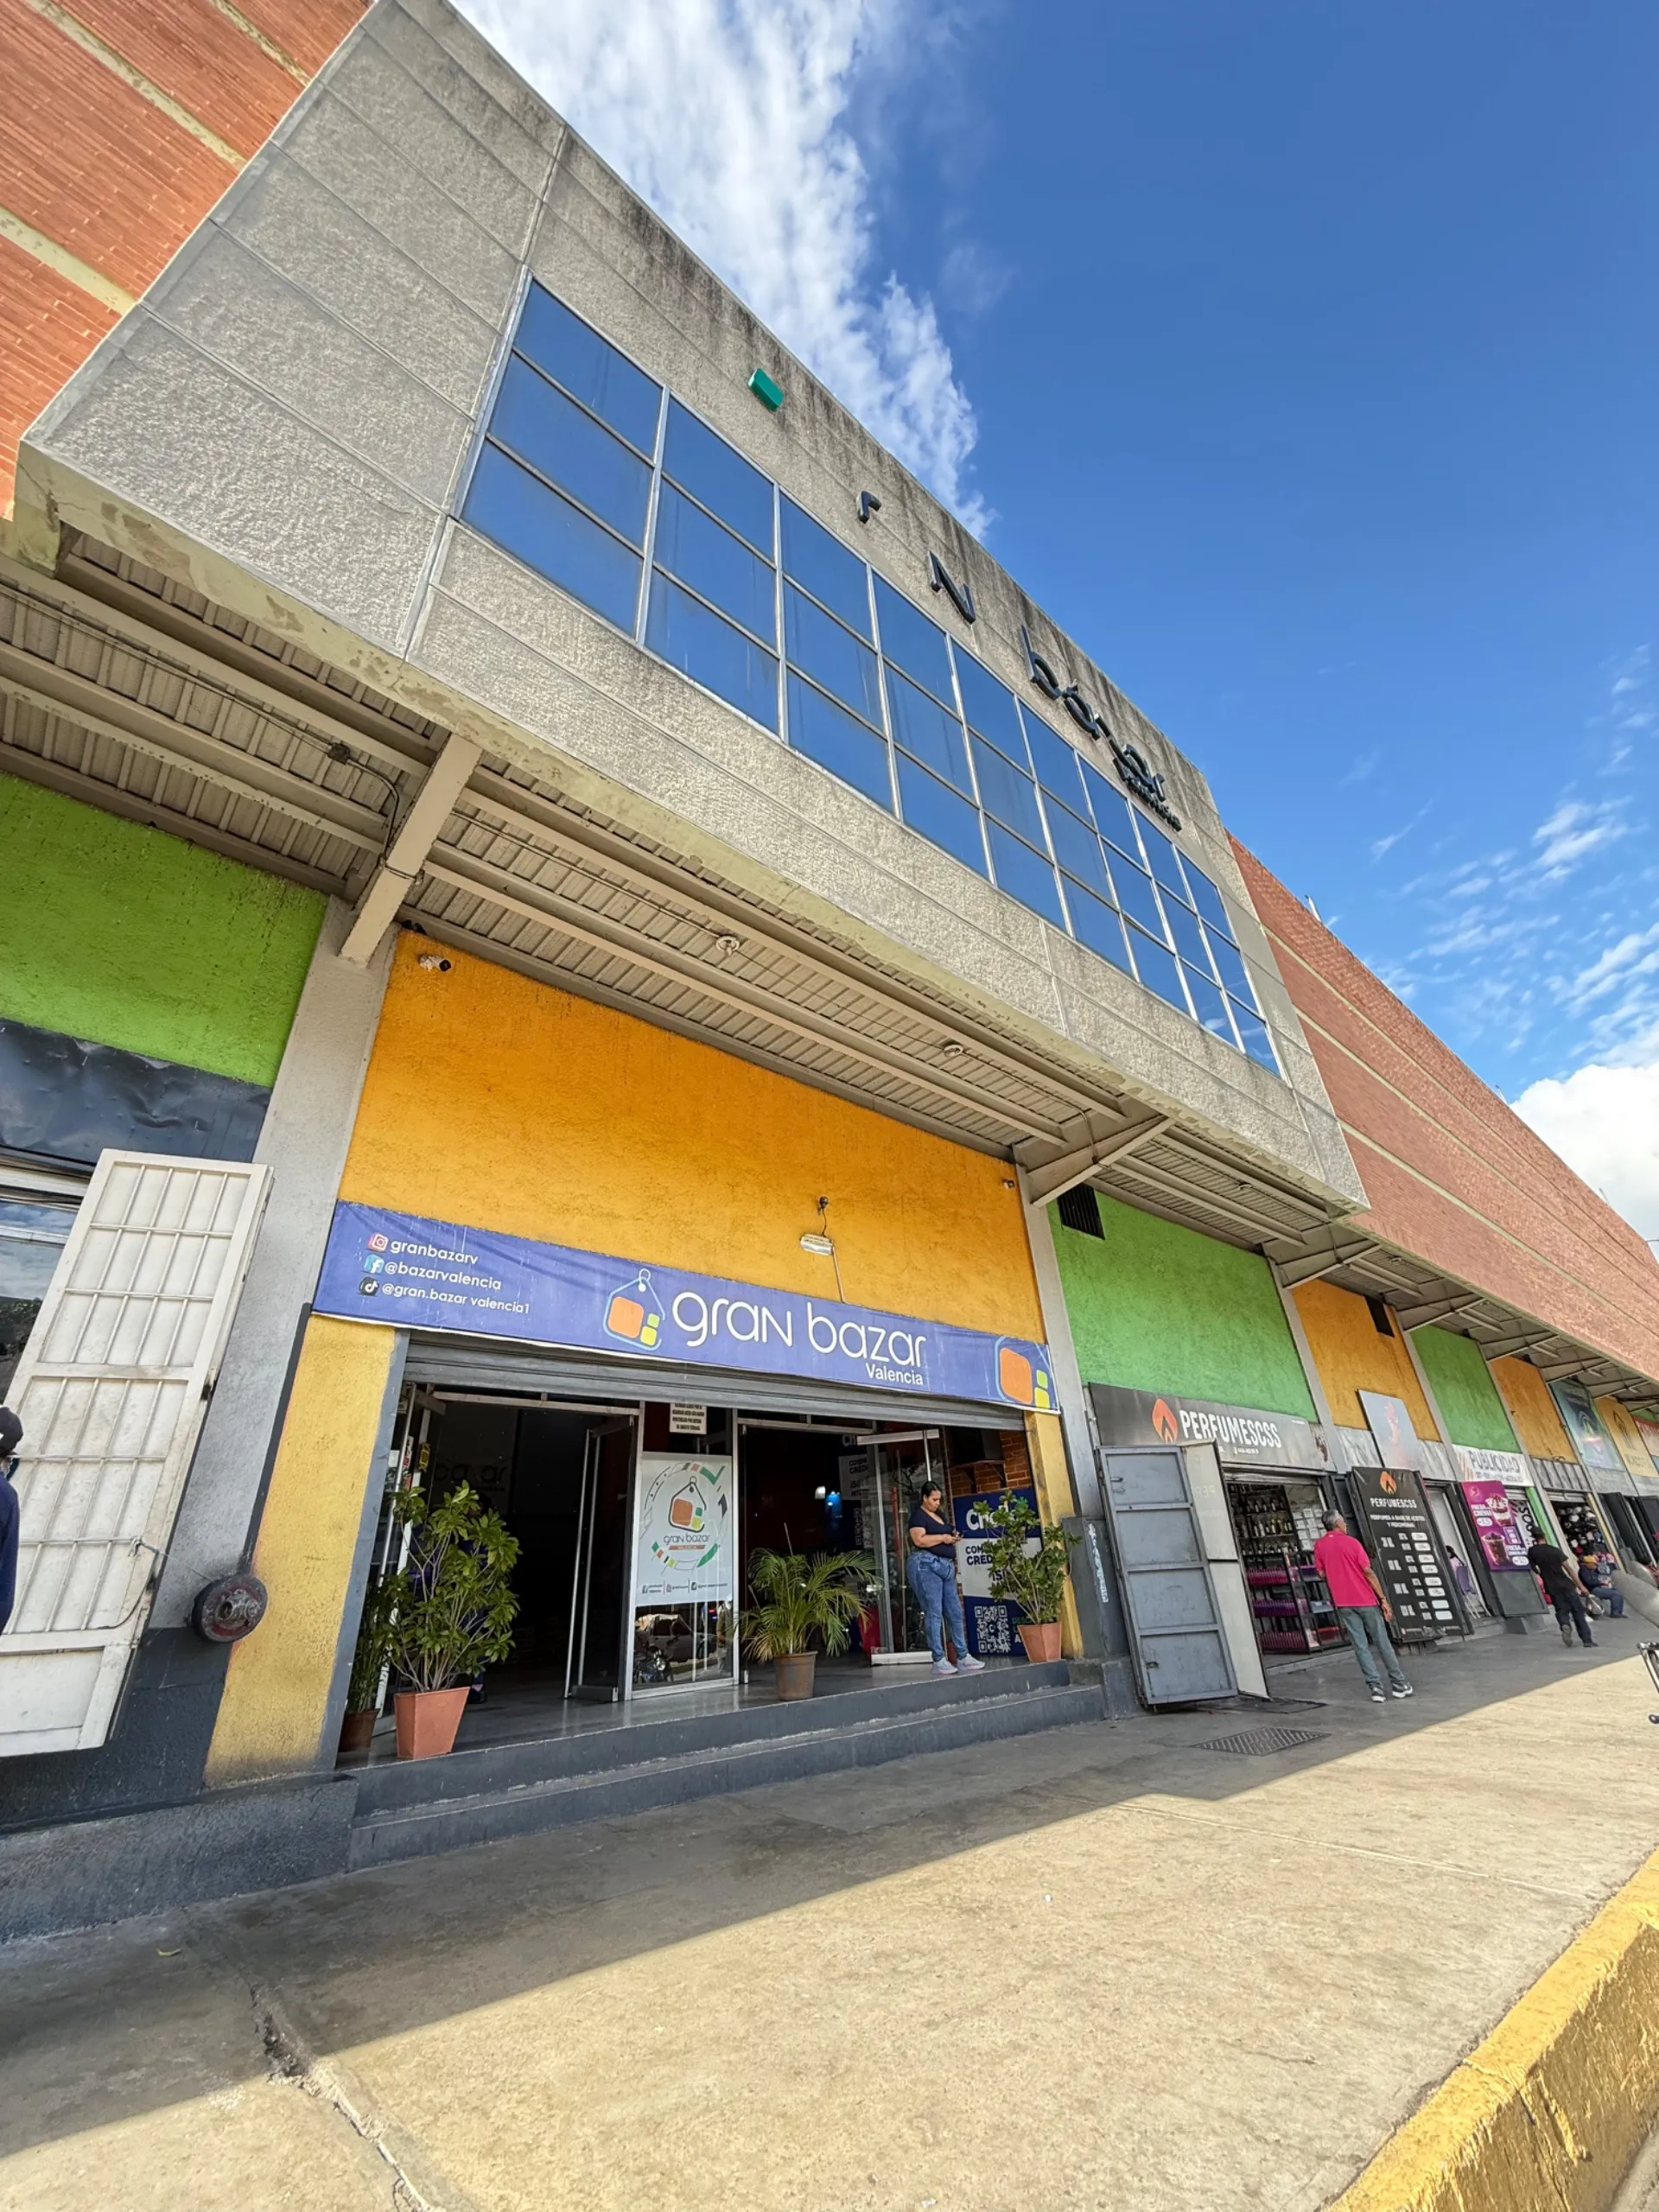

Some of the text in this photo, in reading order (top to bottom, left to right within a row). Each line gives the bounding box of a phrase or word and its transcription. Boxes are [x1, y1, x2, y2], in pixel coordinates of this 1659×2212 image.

[390, 1240, 479, 1265] granbazarv
[385, 1262, 502, 1290] @bazarvalencia
[382, 1283, 530, 1314] @gran.bazar valencia1
[806, 1301, 926, 1367] bazar
[865, 1363, 924, 1385] Valencia
[1179, 1409, 1282, 1448] PERFUMESCSS
[1468, 1450, 1521, 1473] PUBLICIDAD
[966, 1554, 994, 1566] CRED
